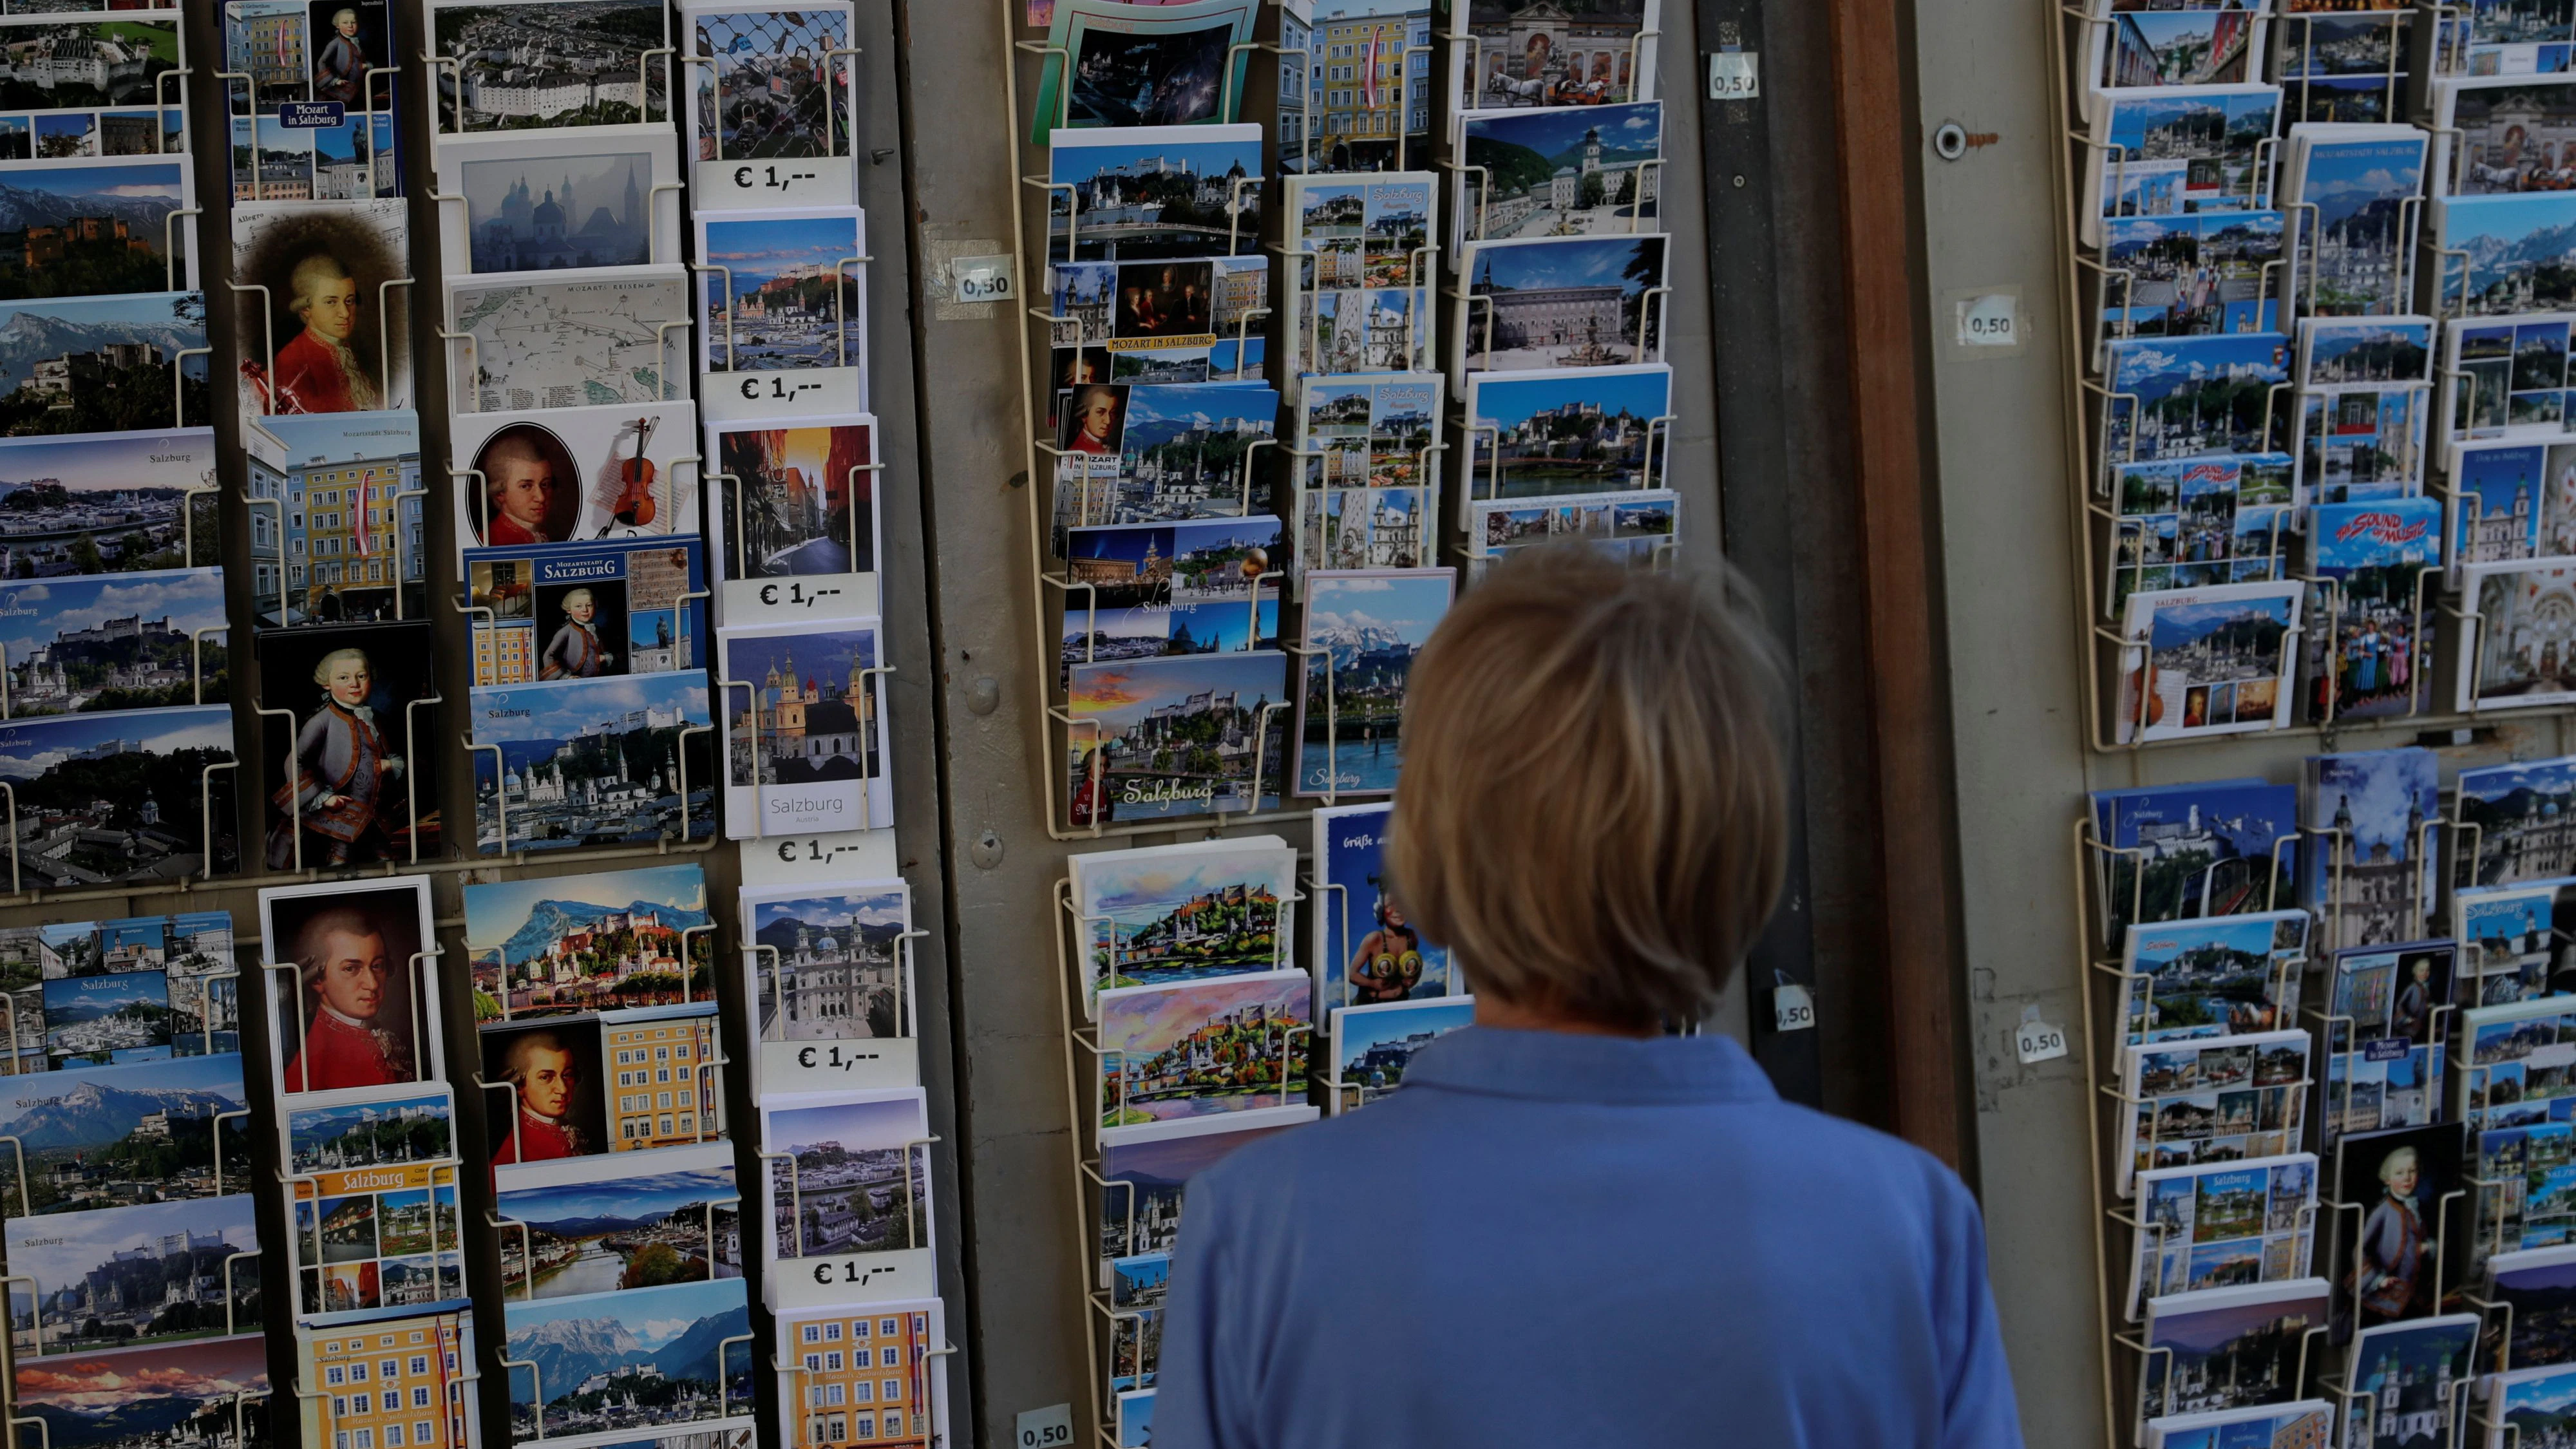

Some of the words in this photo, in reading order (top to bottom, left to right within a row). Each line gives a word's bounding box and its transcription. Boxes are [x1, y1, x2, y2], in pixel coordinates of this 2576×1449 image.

[1714, 77, 1755, 93] 0,50
[296, 104, 328, 115] Mozart
[288, 116, 298, 125] in
[299, 115, 337, 126] Salzburg
[735, 167, 752, 187] €
[1372, 187, 1423, 204] Salzburg
[237, 213, 264, 223] Allegro
[963, 277, 1009, 296] 0,50
[1972, 317, 2010, 335] 0,50
[1112, 339, 1151, 350] MOZART
[1154, 338, 1162, 348] IN
[1166, 335, 1211, 348] SALZBURG
[741, 379, 759, 399] €
[1379, 387, 1429, 404] Salzburg
[149, 452, 191, 464] Salzburg
[2350, 513, 2402, 540] SOUND
[2379, 518, 2428, 545] MUSIC
[761, 585, 778, 605] €
[2155, 596, 2198, 607] SALZBURG
[1142, 598, 1197, 614] Salzburg
[488, 706, 531, 720] Salzburg
[1, 739, 32, 748] Salzburg
[1123, 777, 1214, 811] Salzburg
[771, 798, 843, 814] Salzburg
[1343, 834, 1373, 849] Grüße
[778, 841, 797, 862] €
[80, 977, 129, 992] Salzburg
[2022, 1034, 2061, 1053] 0,50
[799, 1047, 817, 1067] €
[15, 1095, 60, 1110] Salzburg
[343, 1172, 404, 1191] Salzburg
[24, 1235, 64, 1248] Salzburg
[814, 1264, 832, 1284] €
[319, 1355, 351, 1364] Salzburg
[1023, 1425, 1068, 1446] 0,50
